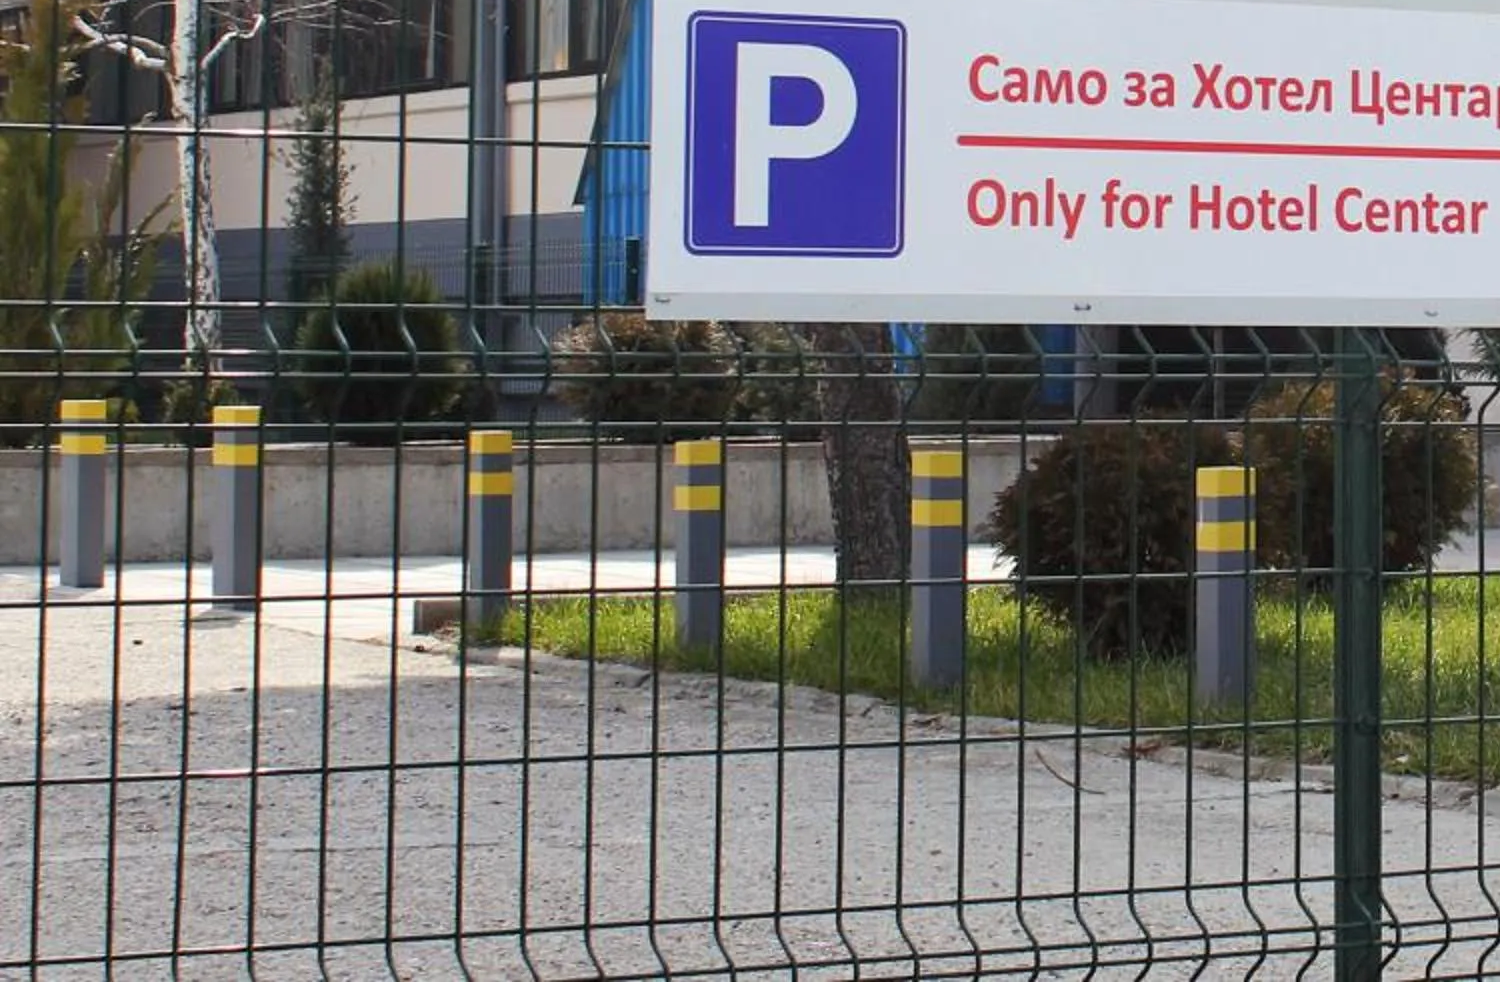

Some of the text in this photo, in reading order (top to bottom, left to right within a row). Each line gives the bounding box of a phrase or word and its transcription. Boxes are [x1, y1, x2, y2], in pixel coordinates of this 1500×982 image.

[969, 54, 1109, 106] Само
[1124, 71, 1177, 108] за
[1192, 63, 1334, 113] Хотел
[733, 40, 859, 228] P
[966, 177, 1086, 240] Only
[1102, 177, 1174, 230] for
[1189, 184, 1319, 233] Hotel
[1334, 185, 1488, 235] Centar
